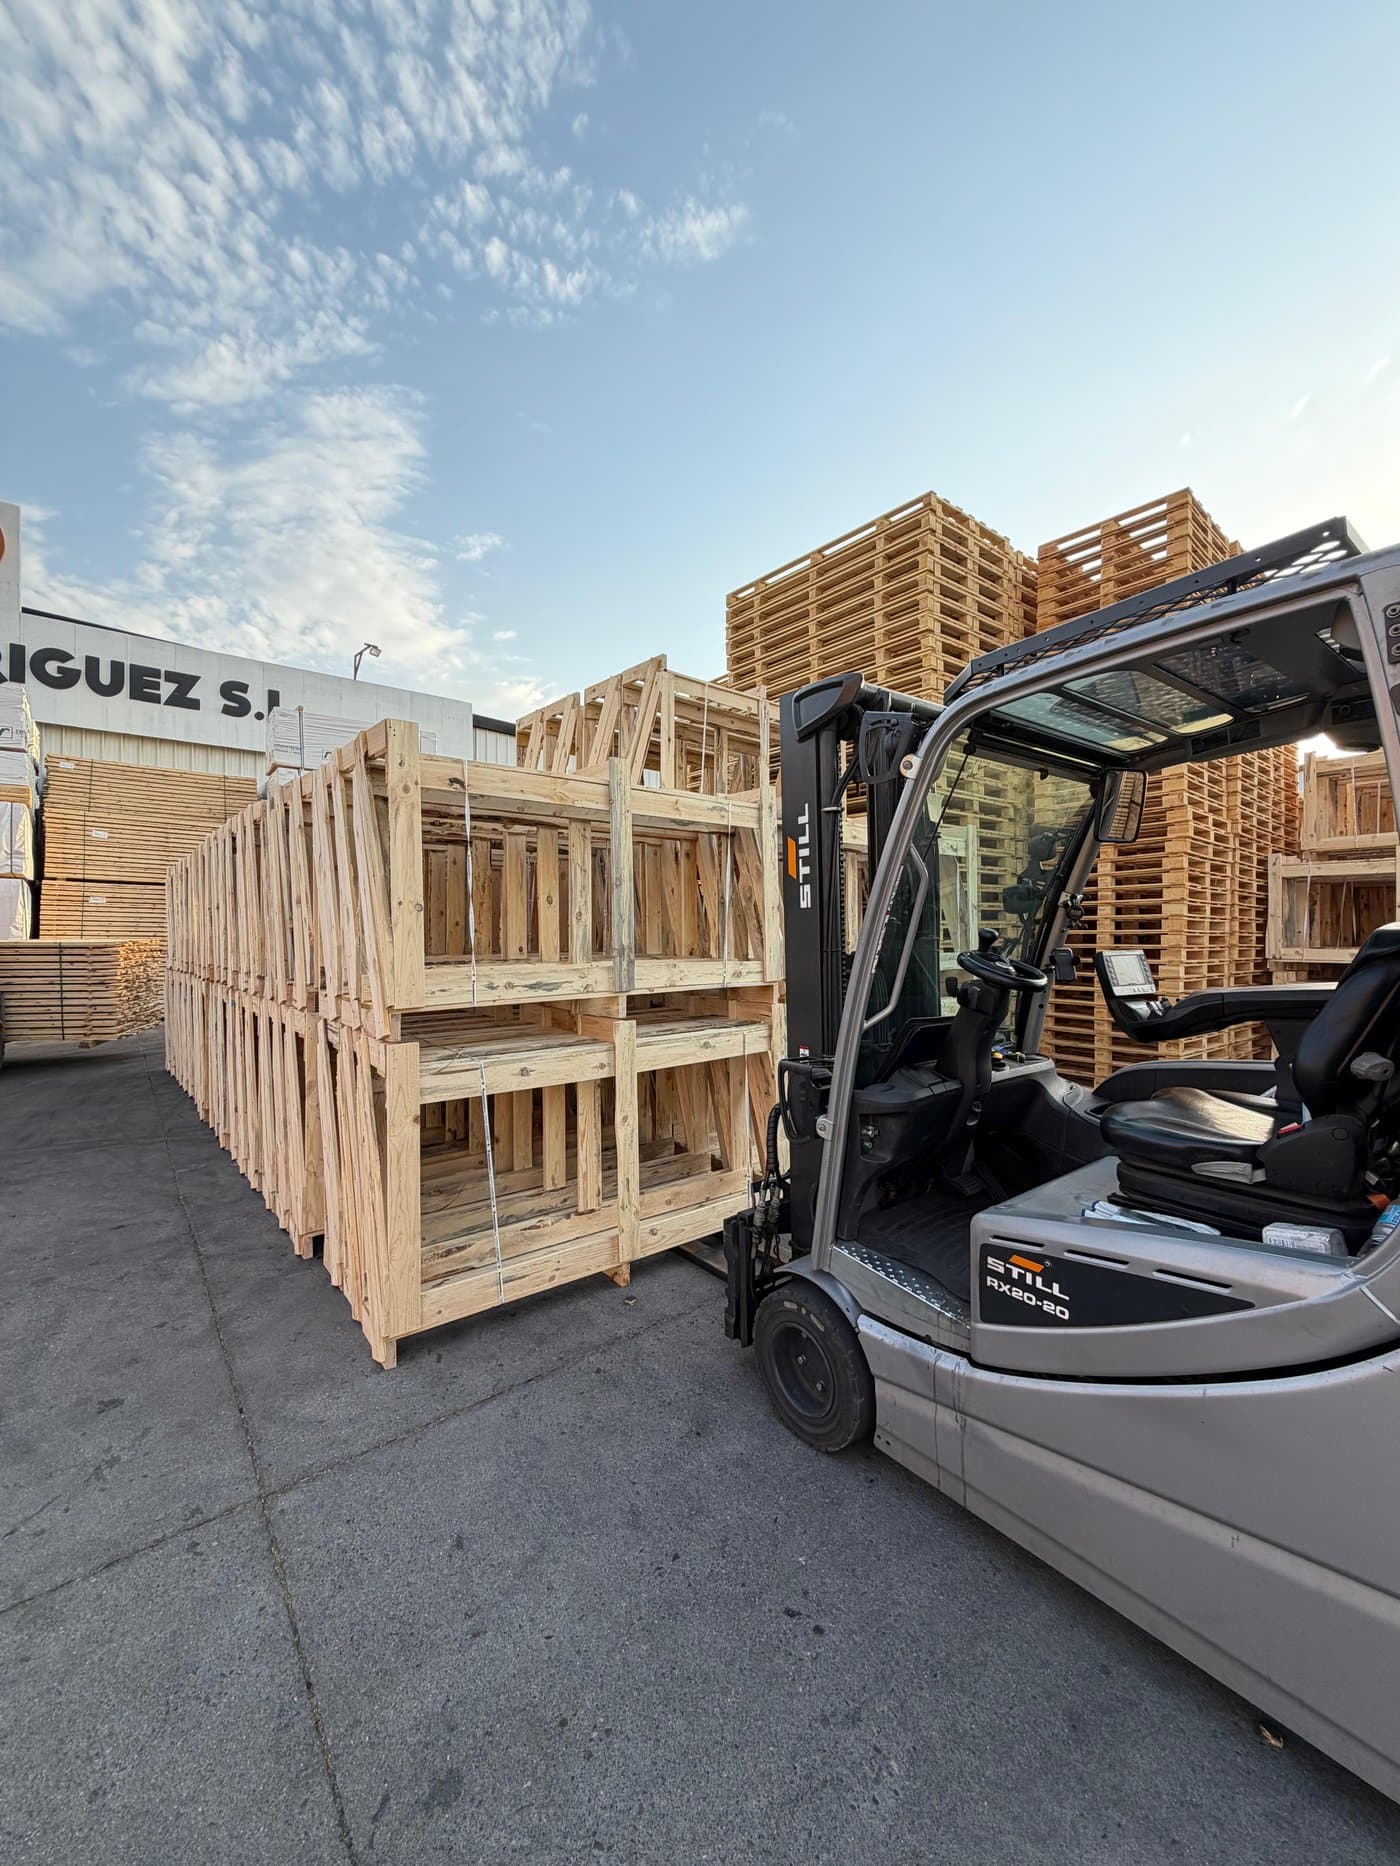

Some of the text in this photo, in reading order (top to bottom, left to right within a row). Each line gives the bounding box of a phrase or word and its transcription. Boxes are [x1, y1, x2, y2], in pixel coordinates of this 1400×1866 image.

[0, 643, 201, 711] IGUEZ
[798, 803, 811, 908] STILL
[986, 1276, 1070, 1320] RX20-20
[987, 1256, 1070, 1300] STILL
